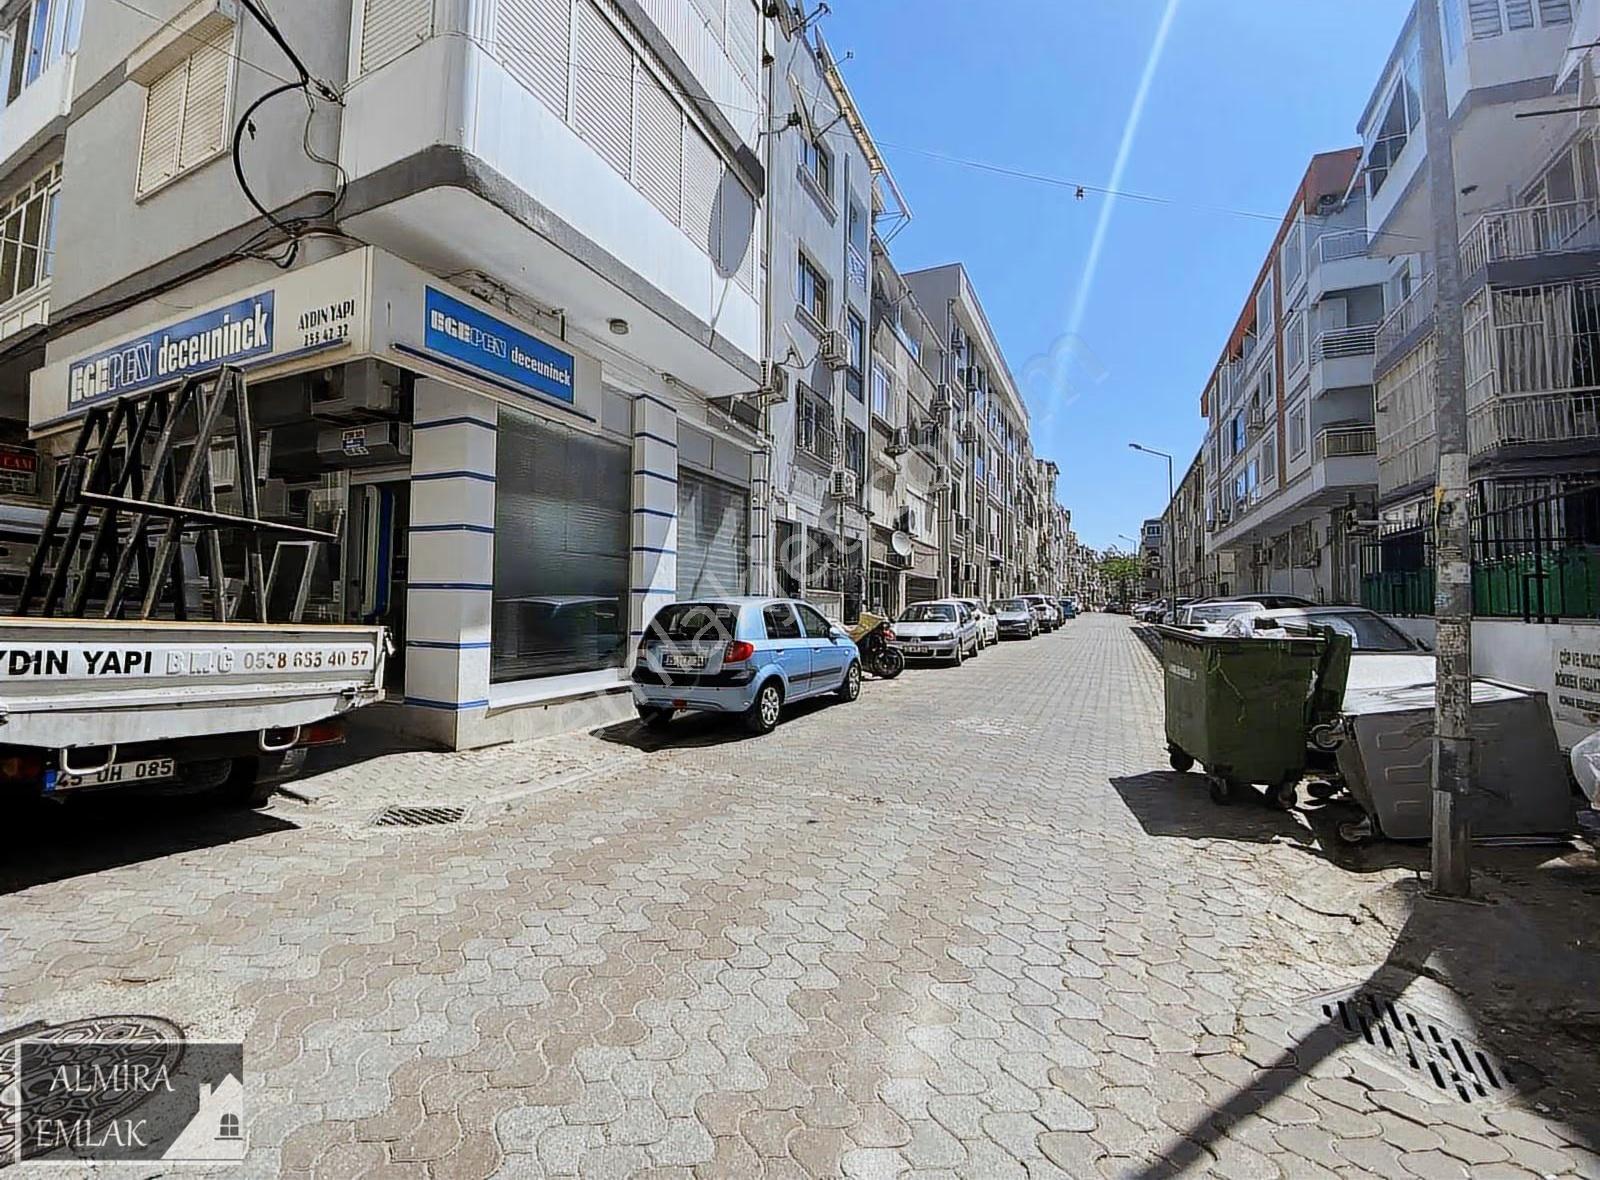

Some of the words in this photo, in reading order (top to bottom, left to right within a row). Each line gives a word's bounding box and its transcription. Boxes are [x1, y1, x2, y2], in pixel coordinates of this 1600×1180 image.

[298, 308, 329, 330] AYDIN
[330, 299, 355, 321] YAPI
[157, 303, 268, 376] deceuninck
[510, 346, 571, 387] deceuninck
[83, 650, 153, 675] YAPI
[328, 651, 346, 666] 40
[351, 650, 369, 666] 57
[135, 760, 172, 778] 085
